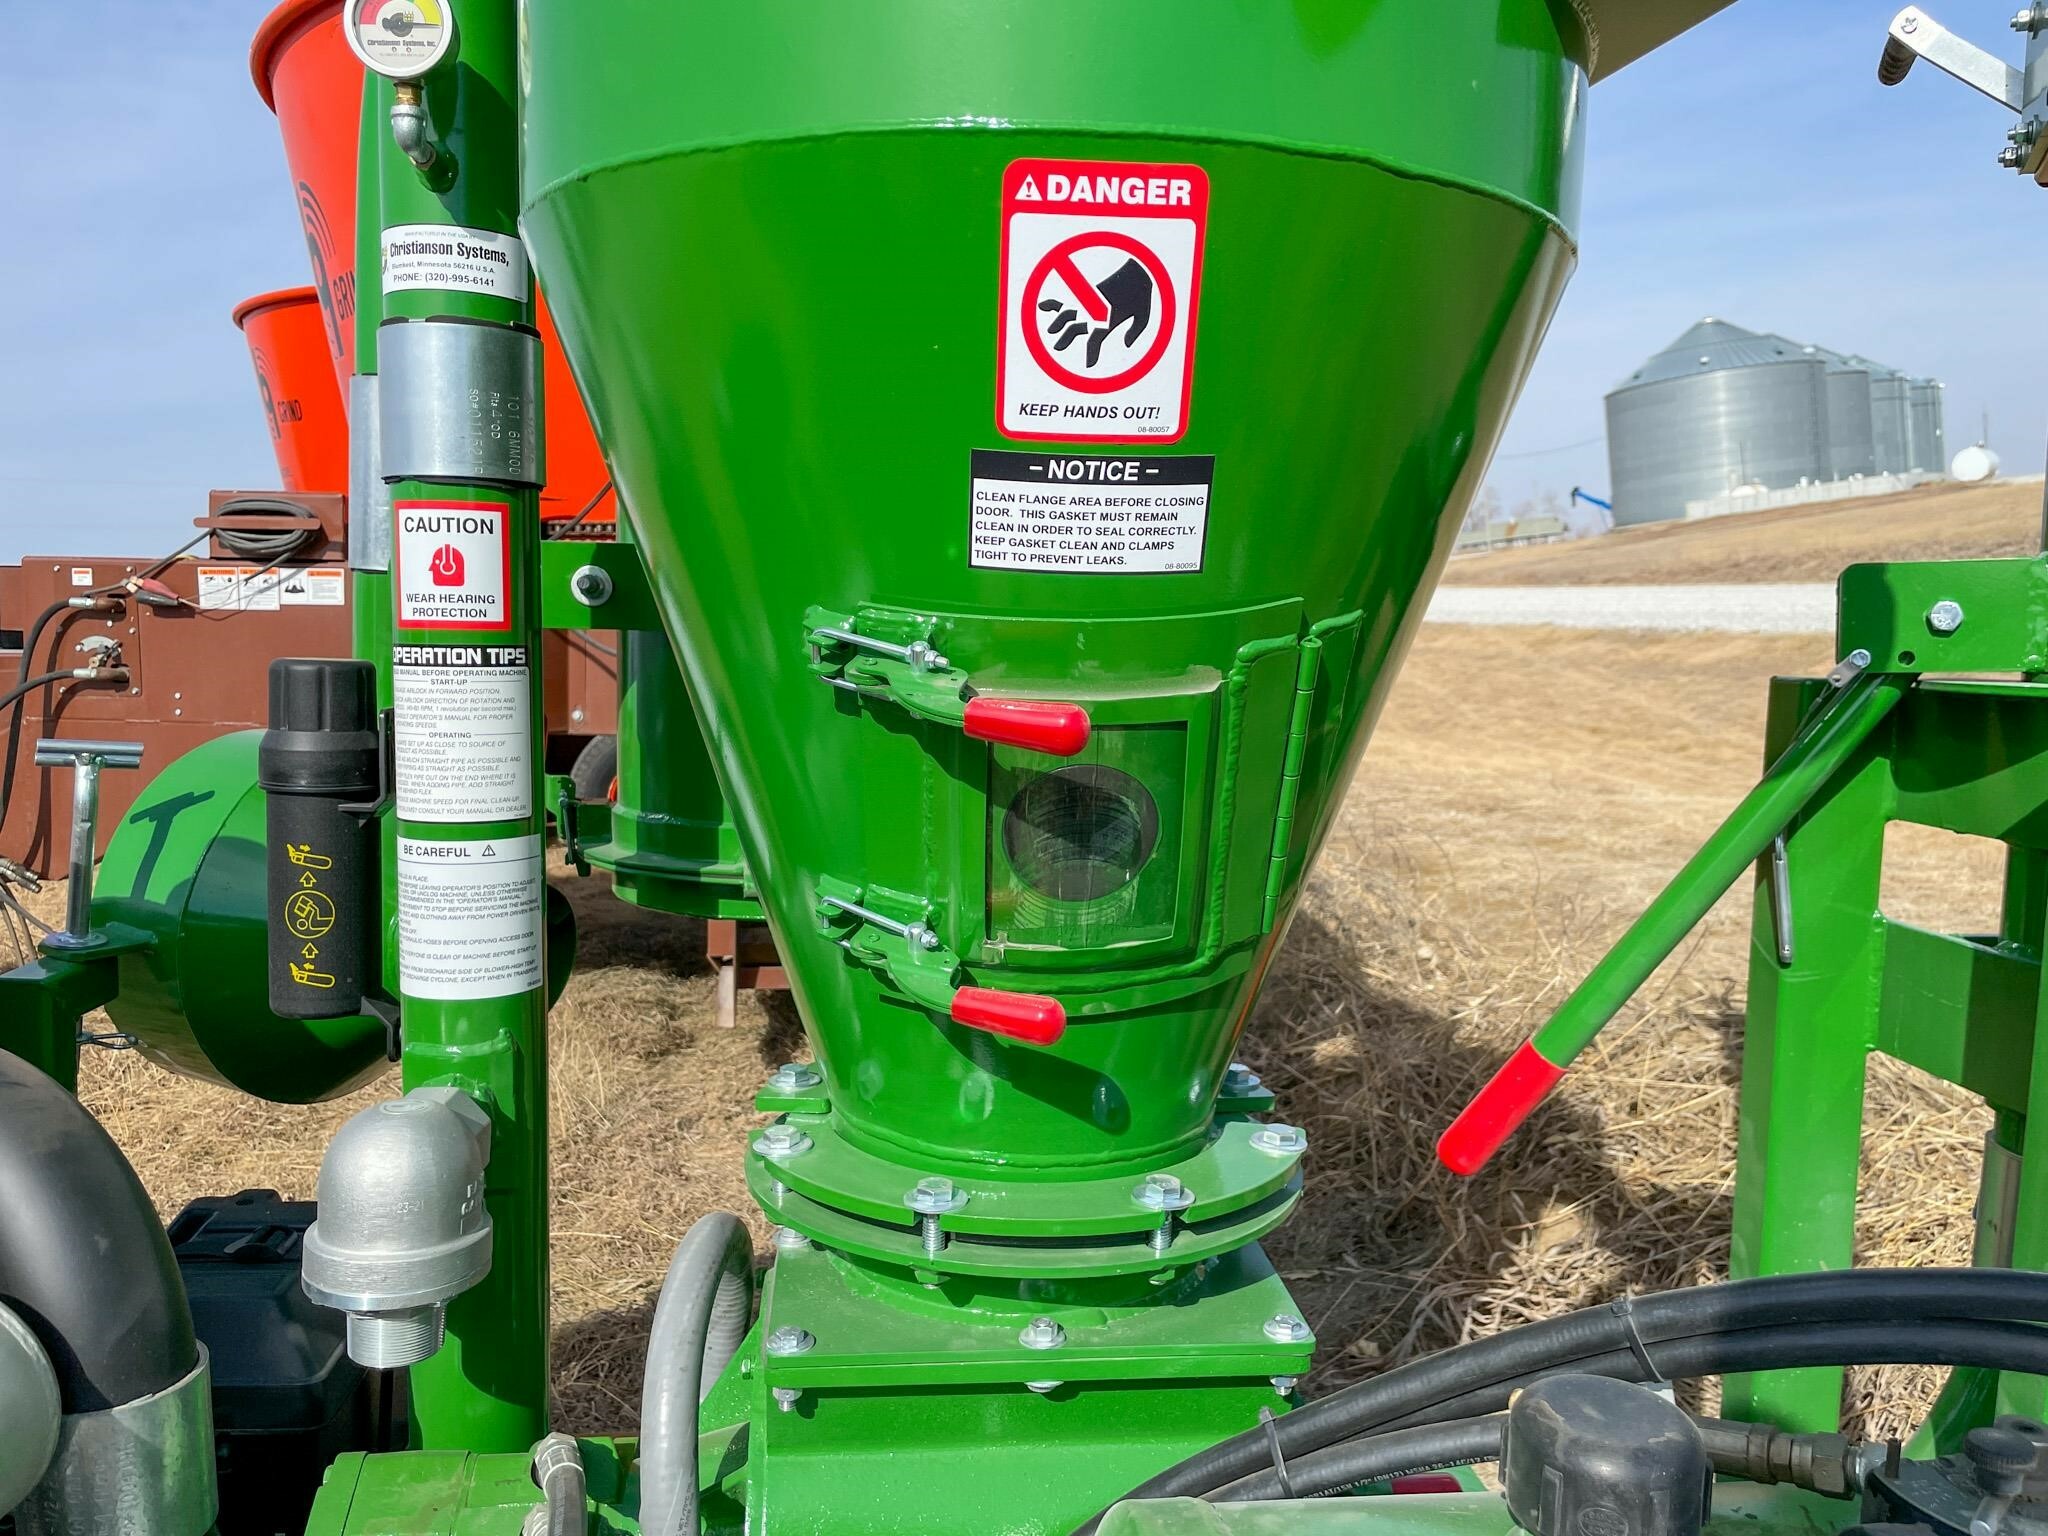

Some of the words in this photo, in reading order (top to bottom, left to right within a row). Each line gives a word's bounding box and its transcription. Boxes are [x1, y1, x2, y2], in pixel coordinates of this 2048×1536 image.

[1046, 174, 1192, 206] DANGER
[390, 241, 453, 258] Christianson
[457, 242, 509, 267] Systems,
[417, 260, 452, 268] Minnesota
[453, 262, 474, 270] 56216
[393, 272, 422, 283] PHONE:
[425, 272, 494, 287] (320)-995-6141
[278, 399, 303, 423] GRIND
[1019, 403, 1059, 417] KEEP
[1064, 404, 1118, 418] HANDS
[1123, 406, 1161, 420] OUT!
[1048, 460, 1140, 481] NOTICE
[976, 491, 1016, 502] CLEAN
[1018, 494, 1066, 506] FLANGE
[1069, 496, 1102, 507] AREA
[1104, 497, 1152, 507] BEFORE
[1154, 496, 1204, 507] CLOSING
[976, 506, 1012, 518] DOOR.
[1020, 509, 1045, 520] THIS
[1048, 510, 1096, 522] GASKET
[1100, 512, 1132, 522] MUST
[1135, 512, 1178, 522] REMAIN
[404, 516, 494, 534] CAUTION
[976, 521, 1014, 533] CLEAN
[1018, 524, 1028, 533] IN
[1032, 524, 1073, 536] ORDER
[1076, 526, 1092, 536] TO
[1095, 526, 1125, 536] SEAL
[1128, 526, 1197, 536] CORRECTLY.
[974, 536, 1006, 546] KEEP
[1008, 538, 1056, 550] GASKET
[1059, 540, 1098, 550] CLEAN
[1101, 540, 1125, 551] AND
[1128, 541, 1174, 551] CLAMPS
[974, 550, 1008, 561] TIGHT
[1011, 552, 1027, 562] TO
[1030, 554, 1083, 565] PREVENT
[1086, 555, 1127, 566] LEAKS.
[1164, 562, 1198, 570] 08-80095
[406, 593, 436, 603] WEAR
[439, 594, 496, 604] HEARING
[412, 607, 488, 618] PROTECTION
[486, 648, 526, 665] TIPS
[404, 844, 414, 855] BE
[416, 846, 471, 858] CAREFUL
